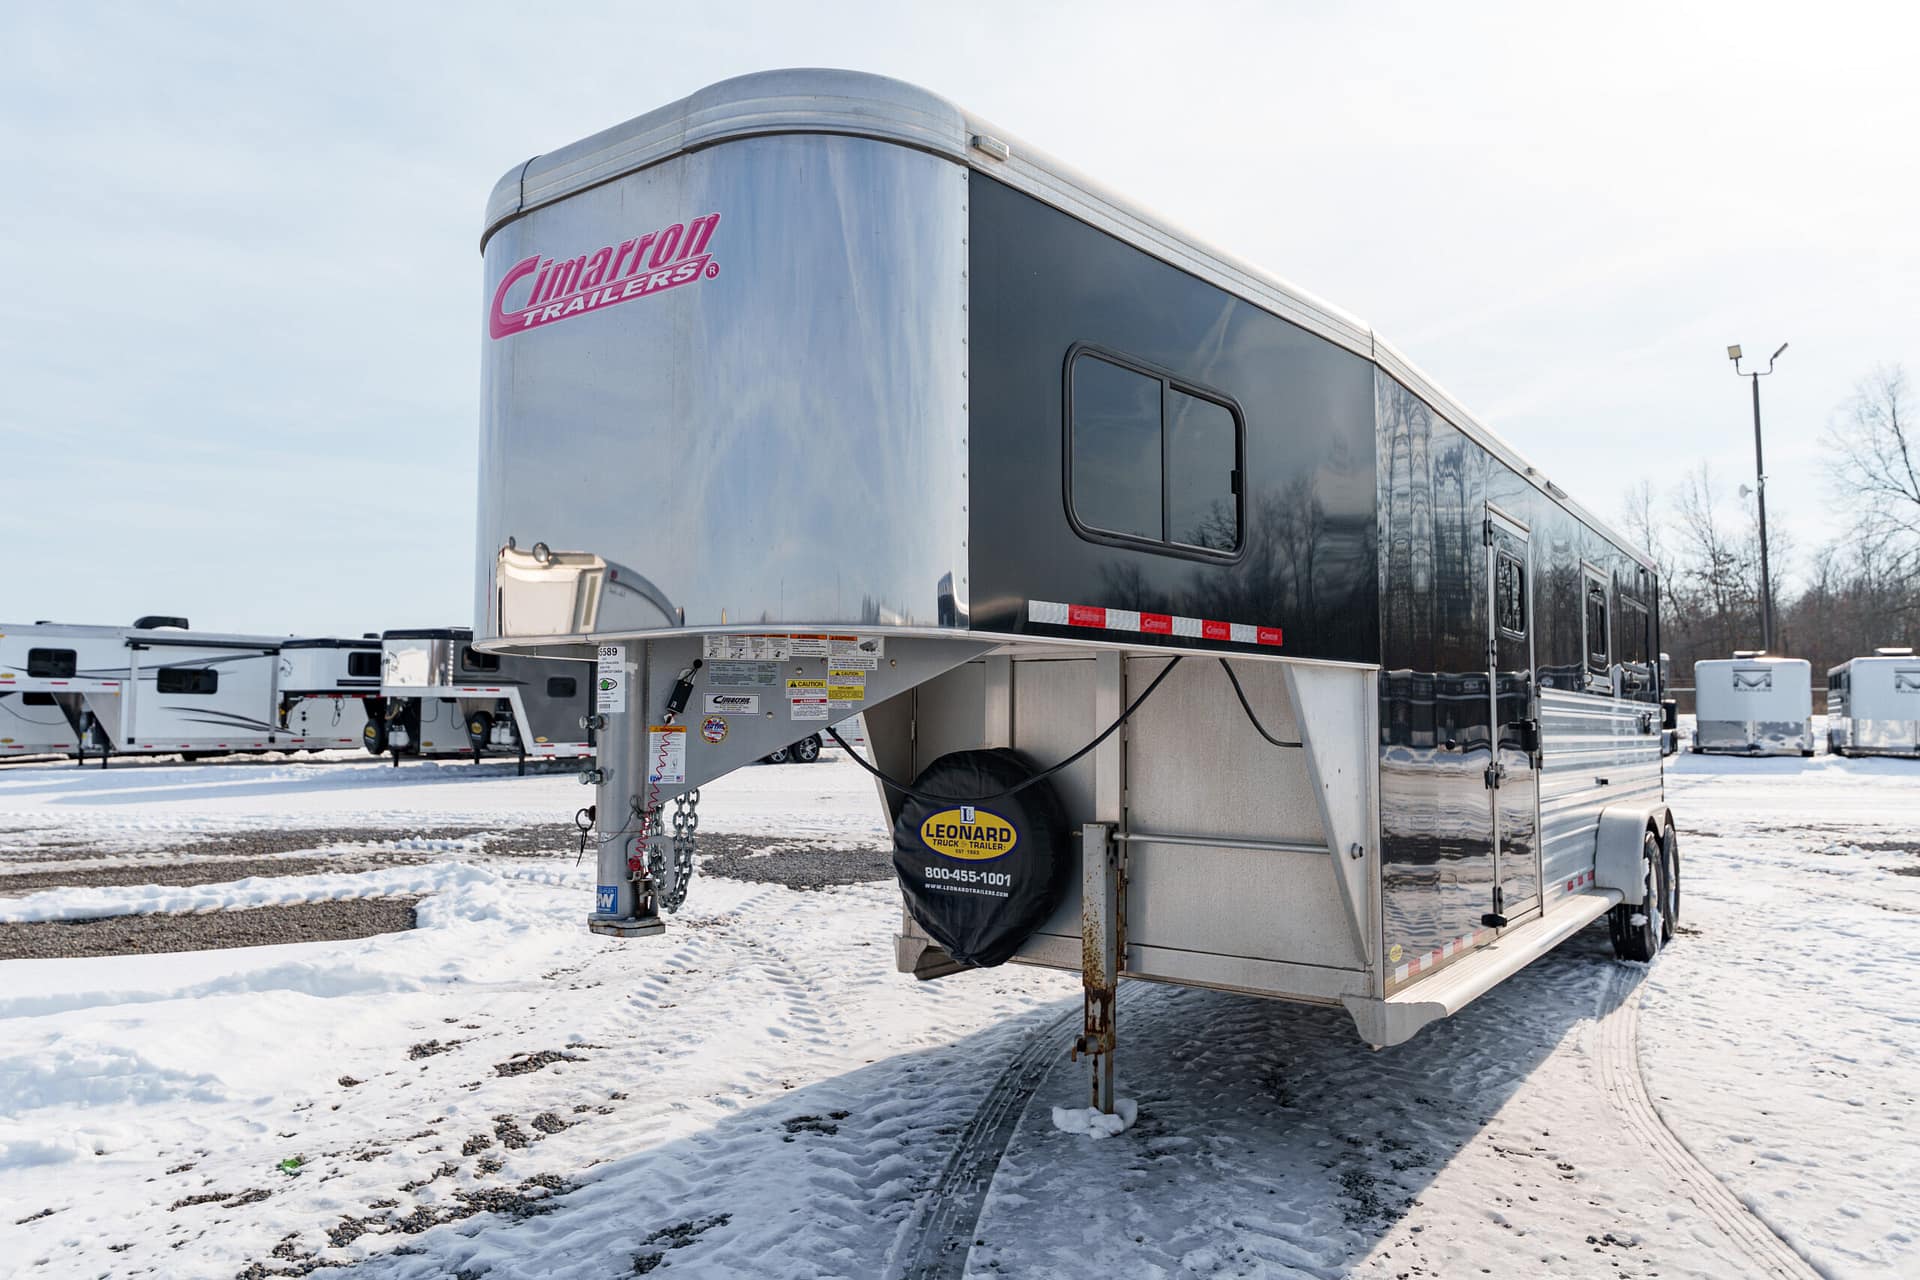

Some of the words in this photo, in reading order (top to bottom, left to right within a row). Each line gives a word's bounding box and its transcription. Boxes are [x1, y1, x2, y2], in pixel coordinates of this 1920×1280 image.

[490, 213, 721, 340] Cimarron
[523, 261, 699, 327] TRAILERS
[926, 823, 1011, 842] LEONARD
[933, 838, 959, 848] TRUCK
[970, 841, 1003, 851] TRAILER
[925, 866, 1011, 887] 800-455-1001
